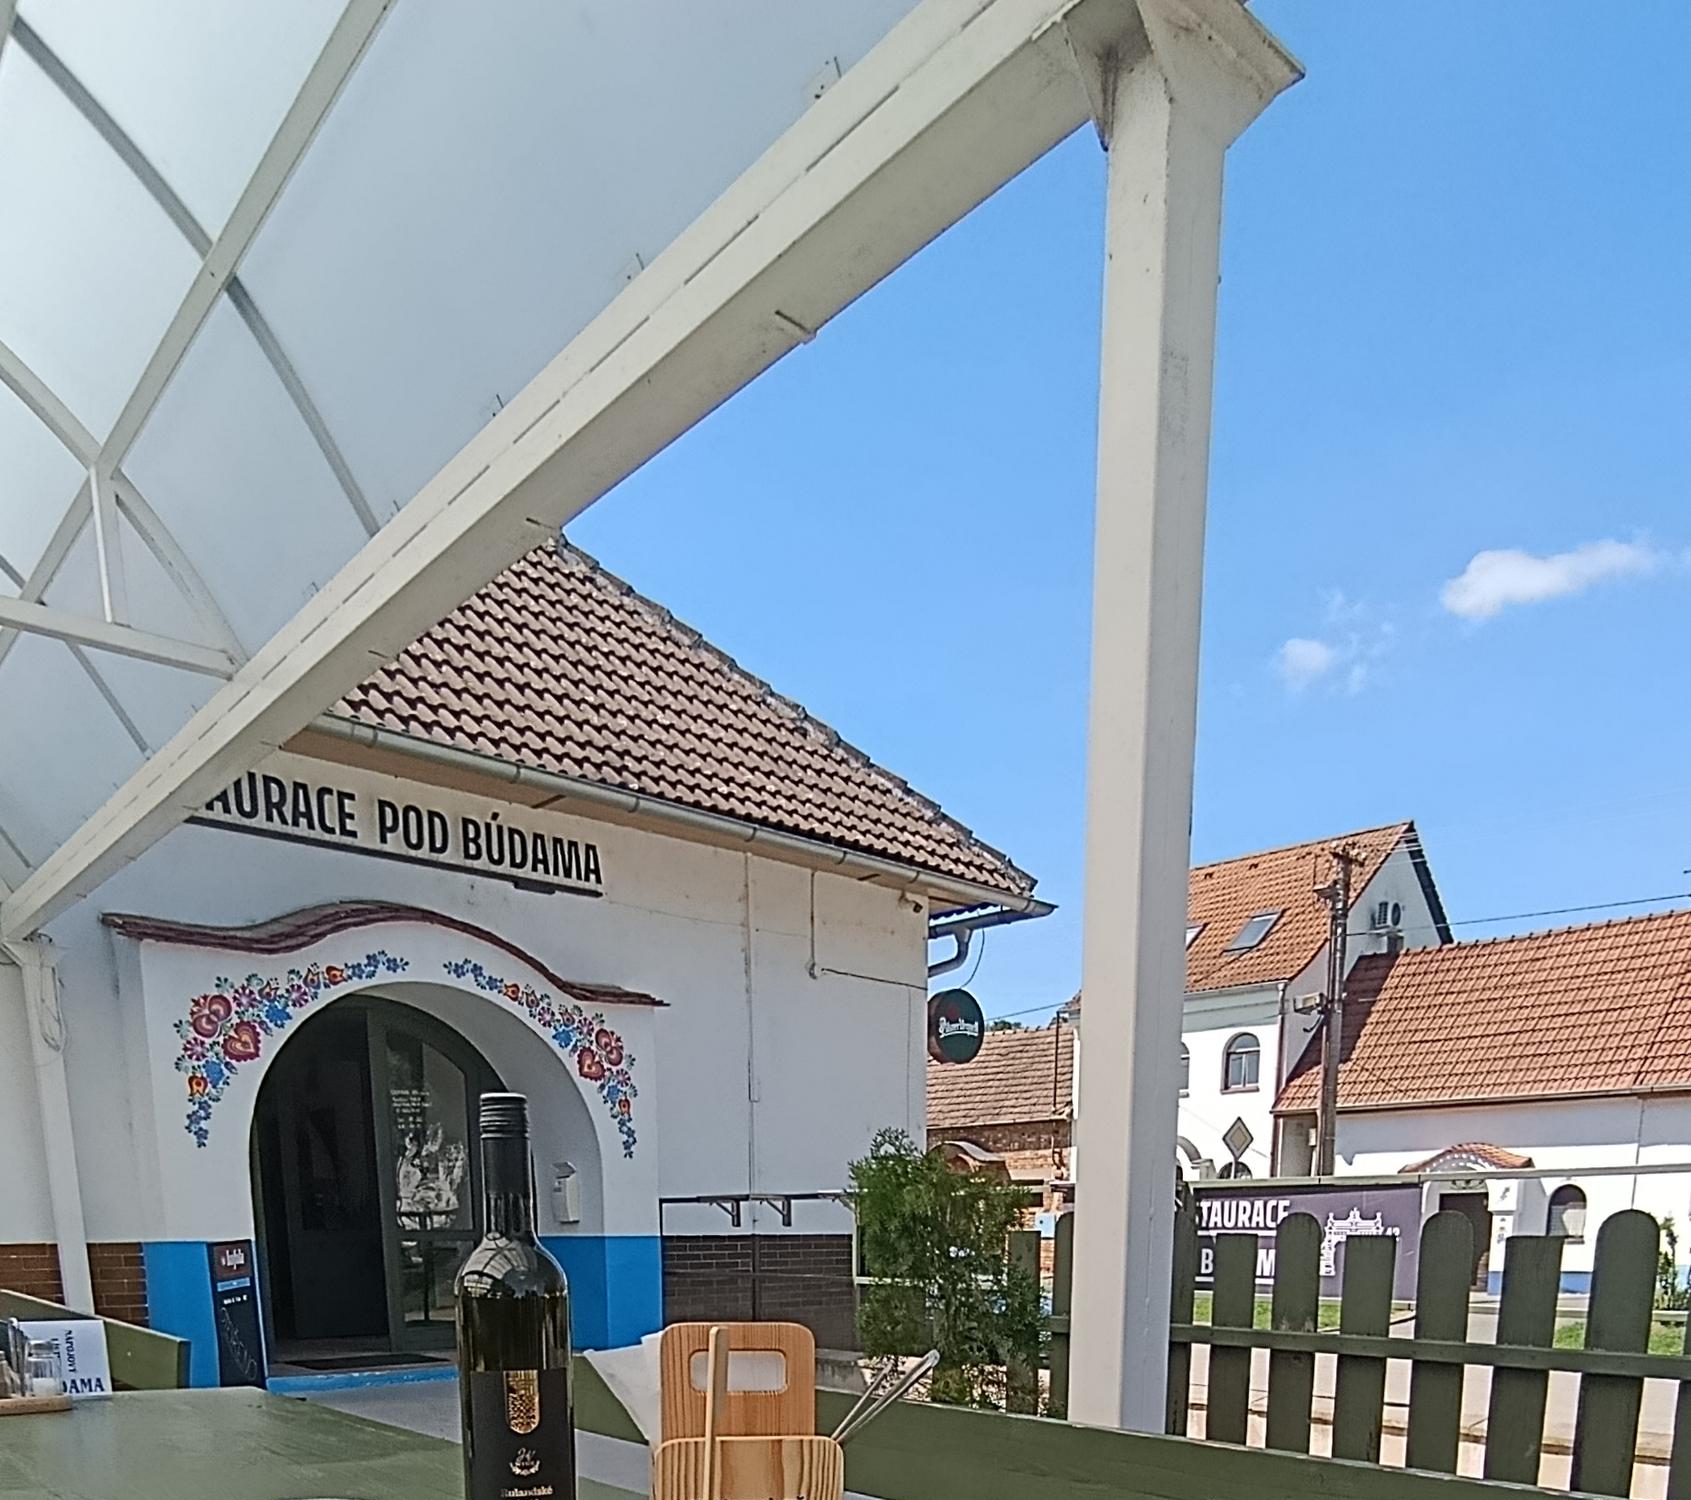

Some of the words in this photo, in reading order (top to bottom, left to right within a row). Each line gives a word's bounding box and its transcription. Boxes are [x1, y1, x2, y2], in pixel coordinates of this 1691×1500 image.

[205, 771, 358, 838] AURACE
[378, 799, 449, 854] POD
[462, 812, 603, 884] BÚDAMA
[1196, 1199, 1290, 1229] TAURACE
